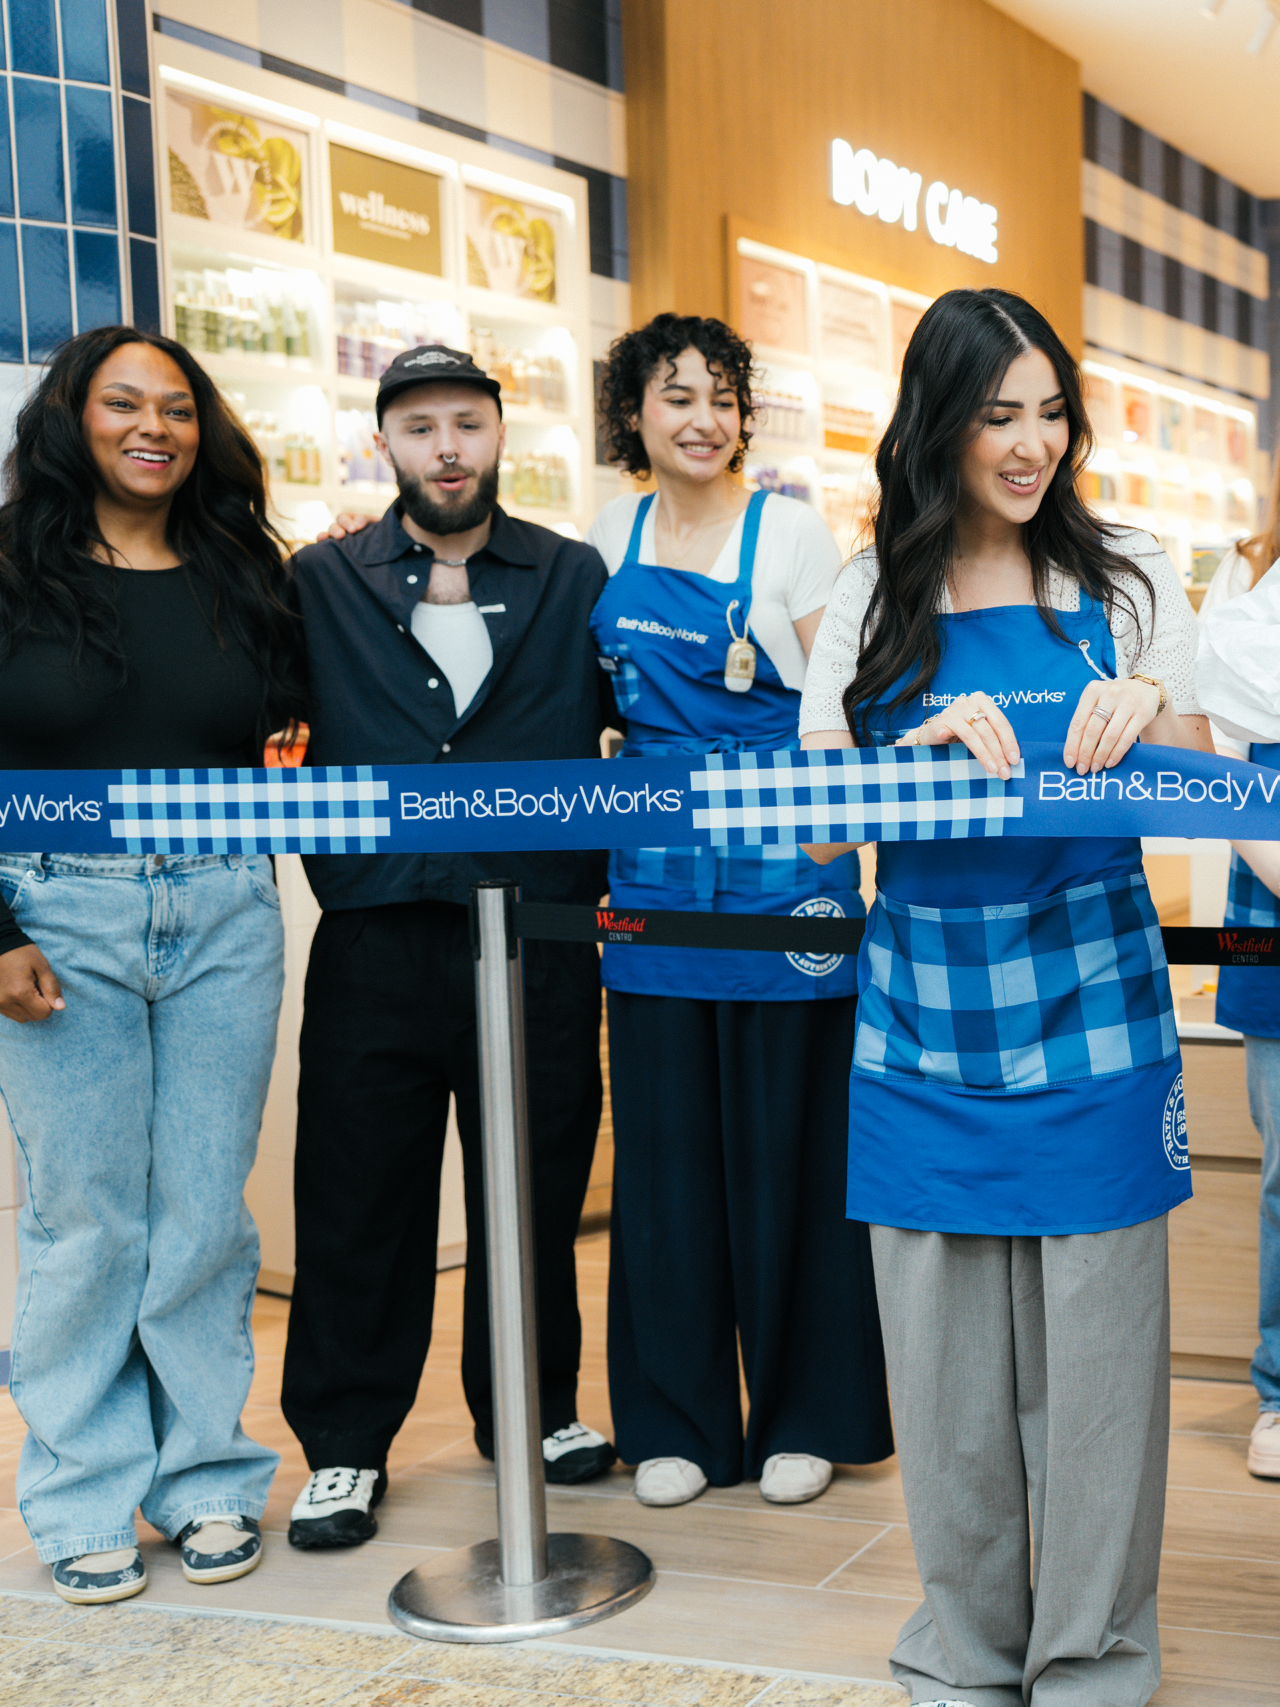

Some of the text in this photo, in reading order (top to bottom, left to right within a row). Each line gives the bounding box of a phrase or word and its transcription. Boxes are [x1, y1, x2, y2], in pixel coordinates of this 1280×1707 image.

[831, 137, 998, 264] BODY CARE
[339, 191, 435, 238] wellness
[596, 911, 646, 932] Westfield
[608, 932, 632, 942] CENTRO
[1216, 932, 1274, 953] Westfield
[1232, 954, 1259, 963] CENTRO
